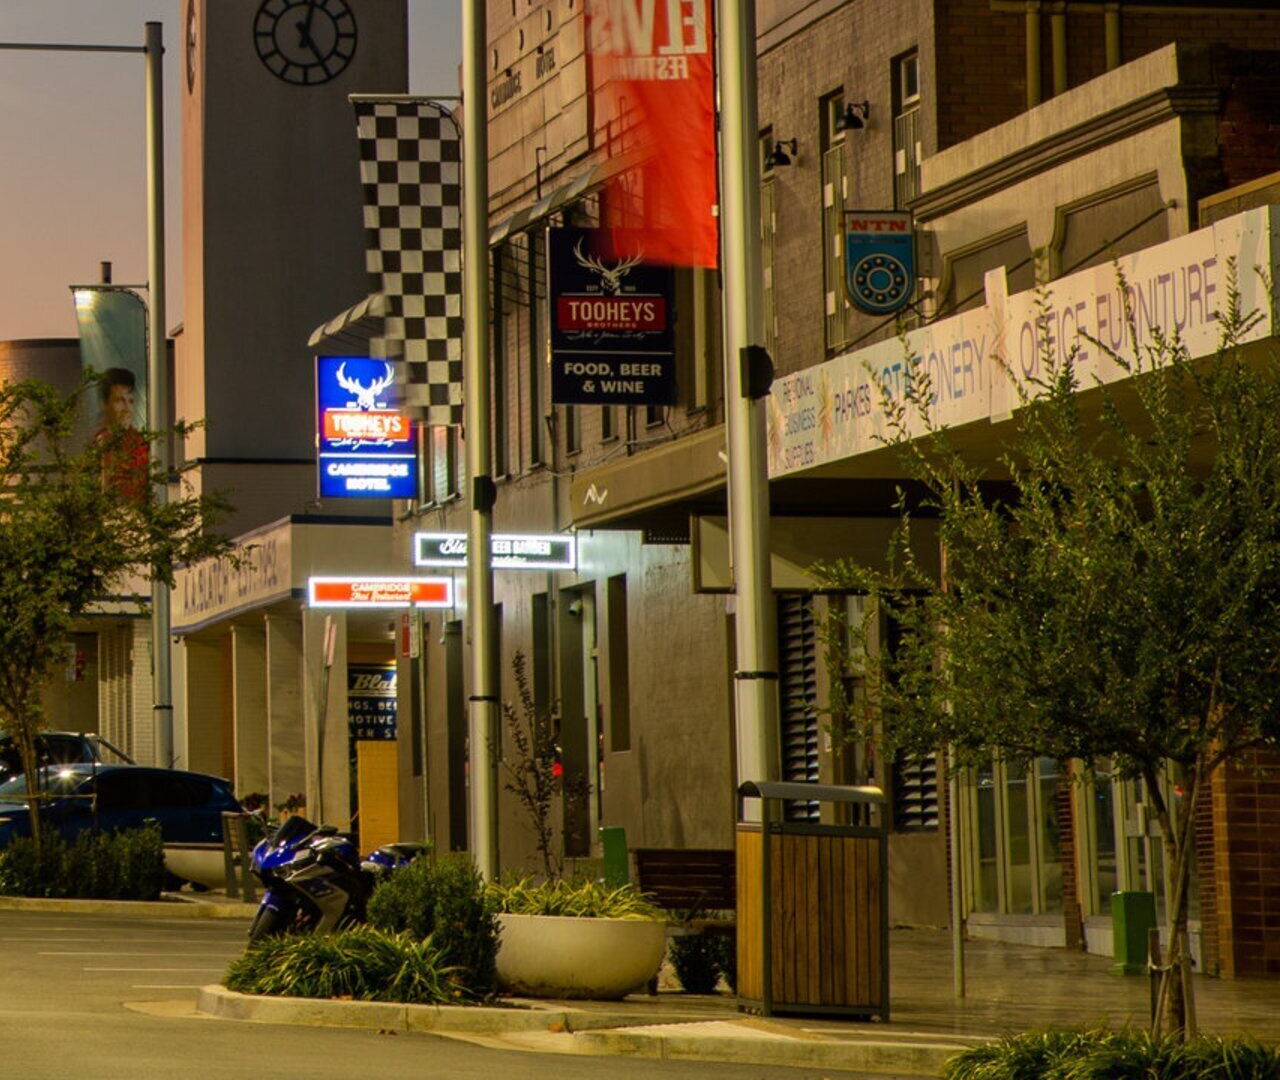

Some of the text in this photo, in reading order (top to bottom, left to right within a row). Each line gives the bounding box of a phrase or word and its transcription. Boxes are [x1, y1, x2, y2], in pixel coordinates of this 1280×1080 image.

[851, 219, 907, 232] NTN
[568, 302, 656, 322] TOOHEYS
[834, 383, 872, 424] PARKES
[1096, 257, 1219, 355] FURNITURE
[564, 363, 662, 378] FOOD, BEER
[582, 381, 645, 394] & WINE
[331, 414, 402, 433] TOOHEYS
